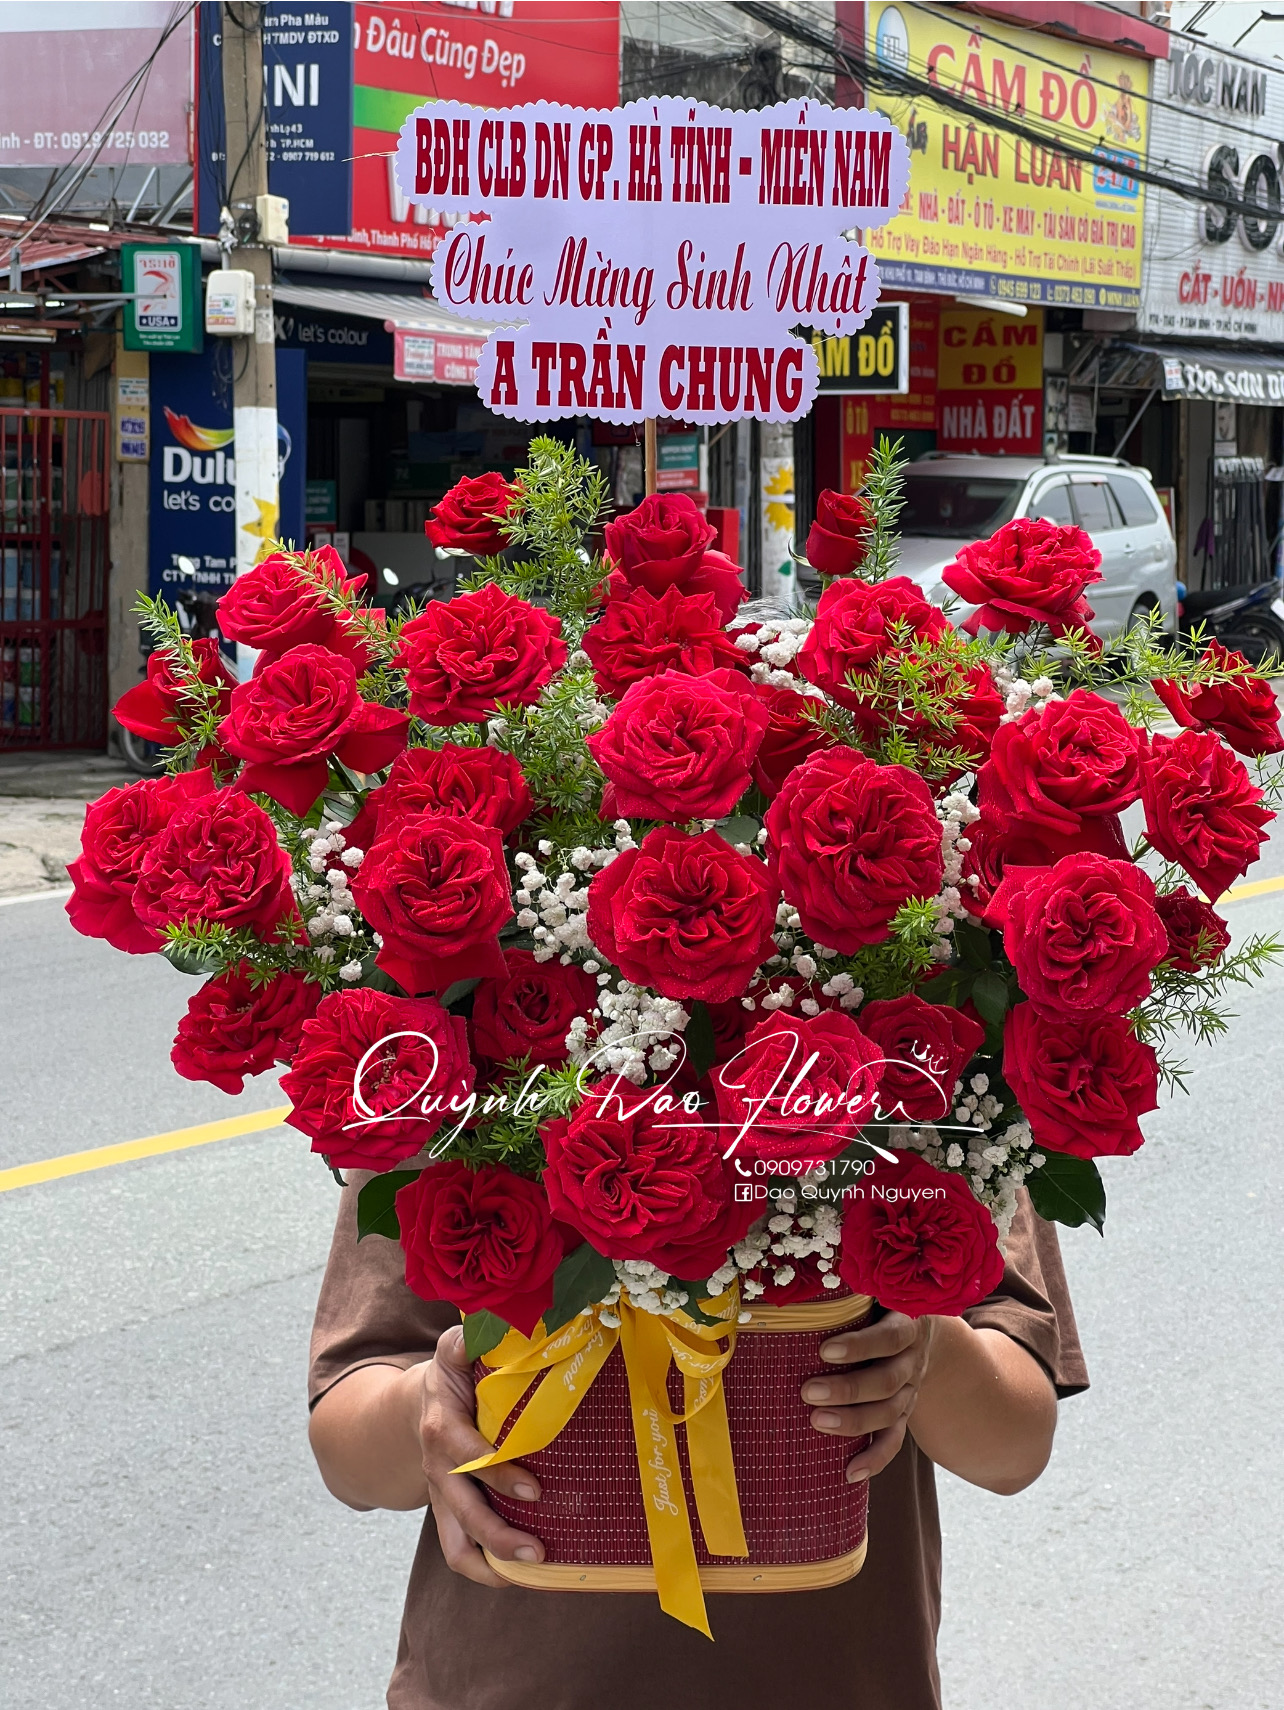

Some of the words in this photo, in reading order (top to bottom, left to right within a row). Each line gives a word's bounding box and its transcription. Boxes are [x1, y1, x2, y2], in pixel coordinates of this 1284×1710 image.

[280, 14, 302, 27] Pha
[307, 31, 340, 44] ĐTXD
[366, 16, 416, 60] Đâu
[420, 27, 478, 80] Cũng
[481, 39, 526, 88] Đẹp
[263, 63, 319, 107] NI
[1039, 53, 1098, 131] ĐỒ
[34, 132, 58, 149] ĐT:
[138, 131, 170, 149] 032
[414, 117, 470, 196] BĐH
[478, 119, 527, 198] CLB
[534, 121, 571, 199] DN
[578, 121, 620, 202] GP.
[627, 106, 663, 203] HÀ
[670, 108, 733, 205] TĨNH
[758, 102, 828, 207] MIỀN
[832, 130, 893, 209] NAM
[370, 230, 399, 247] Thành
[400, 232, 418, 249] Phố
[919, 188, 938, 223] NHÀ
[948, 188, 965, 226] ĐẤT
[974, 195, 980, 229] Ô
[983, 197, 994, 230] TÔ
[1002, 206, 1013, 234] XE
[1015, 203, 1035, 237] MÁY
[1043, 206, 1056, 239] TÀI
[1058, 206, 1076, 241] SẢN
[1120, 223, 1136, 250] CAO
[904, 234, 920, 258] Vay
[444, 231, 534, 306] Chúc
[543, 235, 656, 326] Mừng
[666, 239, 754, 313] Sinh
[767, 240, 870, 330] Nhật
[1178, 259, 1212, 305] CẮT
[1221, 265, 1258, 310] UỐN
[148, 316, 170, 328] USA
[298, 322, 325, 344] let's
[327, 327, 369, 346] colour
[490, 340, 518, 406] A
[532, 316, 646, 411] TRẦN
[658, 344, 804, 414] CHUNG
[858, 320, 895, 377] ĐỒ
[943, 398, 988, 439] NHÀ
[992, 393, 1036, 439] ĐẤT
[163, 489, 200, 512] let's
[649, 1408, 668, 1447] you
[648, 1445, 672, 1478] for
[652, 1473, 679, 1516] Just
